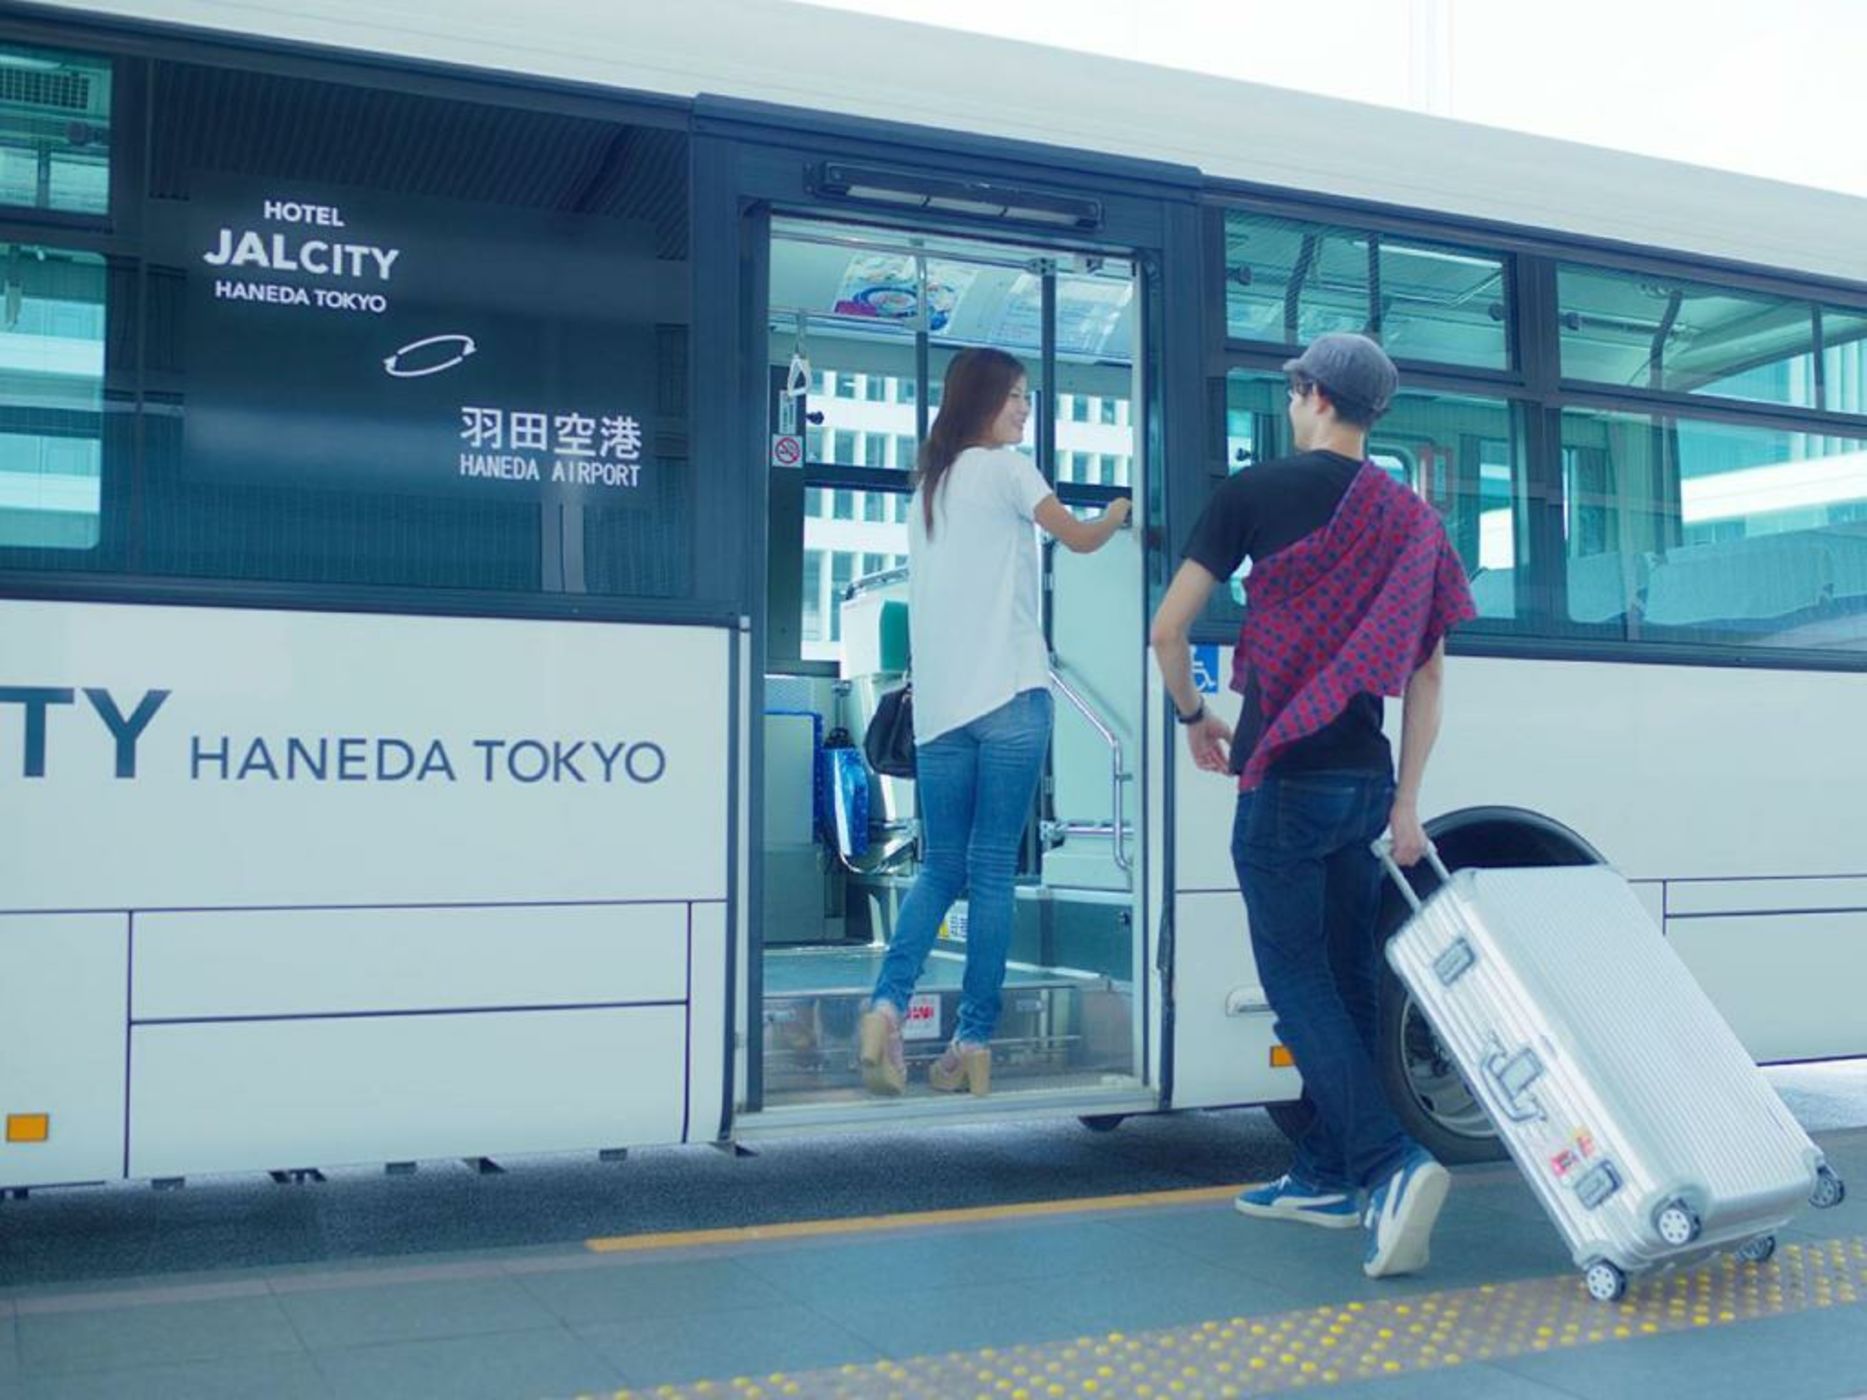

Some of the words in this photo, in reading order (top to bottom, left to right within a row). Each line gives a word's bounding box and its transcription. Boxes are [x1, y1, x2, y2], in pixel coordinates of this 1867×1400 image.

[264, 201, 345, 227] HOTEL
[203, 229, 399, 279] JALCITY
[215, 280, 310, 306] HANEDA
[314, 288, 388, 313] TOKYO
[460, 407, 642, 461] 羽田空港
[460, 453, 540, 480] HANEDA
[551, 460, 642, 488] AIRPORT
[191, 736, 457, 781] HANEDA
[473, 739, 667, 784] TOKYO
